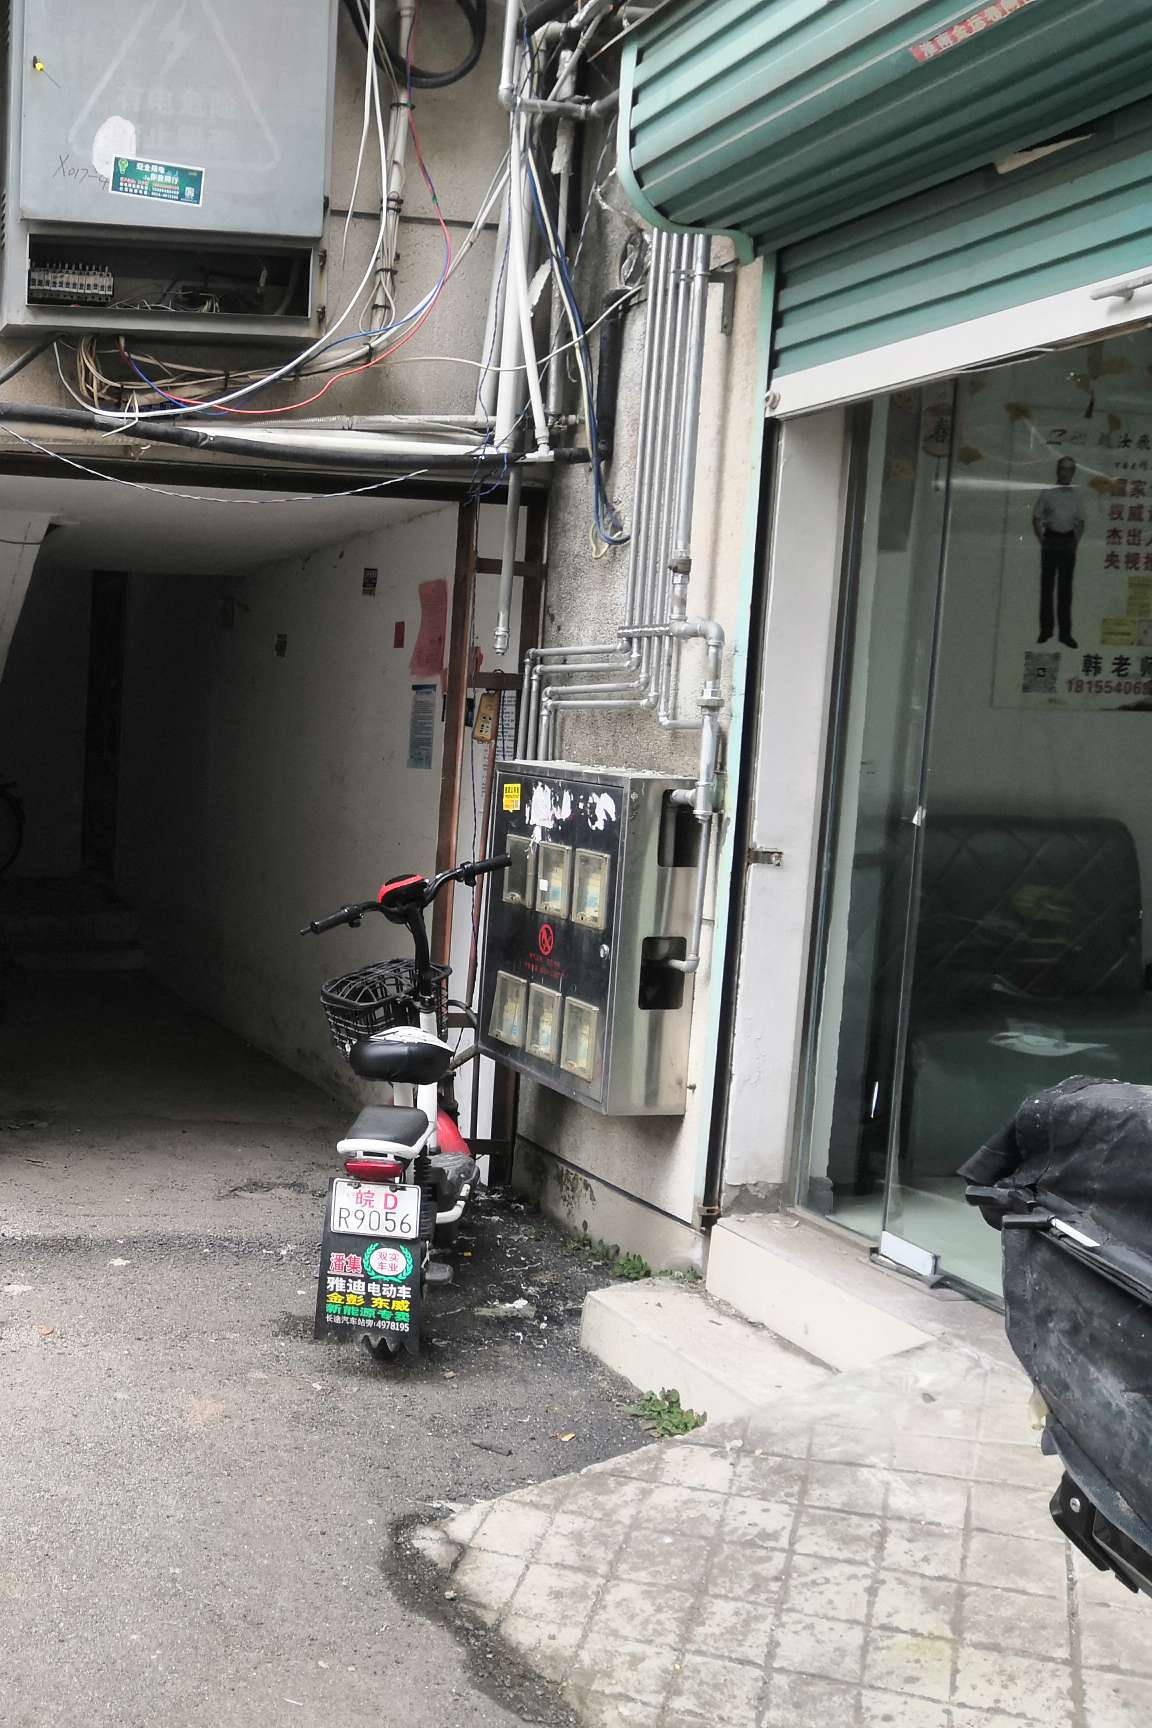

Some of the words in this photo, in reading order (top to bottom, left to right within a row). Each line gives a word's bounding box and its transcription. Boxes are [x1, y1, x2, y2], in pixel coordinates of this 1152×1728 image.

[1107, 503, 1152, 522] 权威
[338, 1208, 412, 1234] R9056
[329, 1252, 363, 1274] 潘集
[326, 1276, 412, 1300] 雅迪电动车
